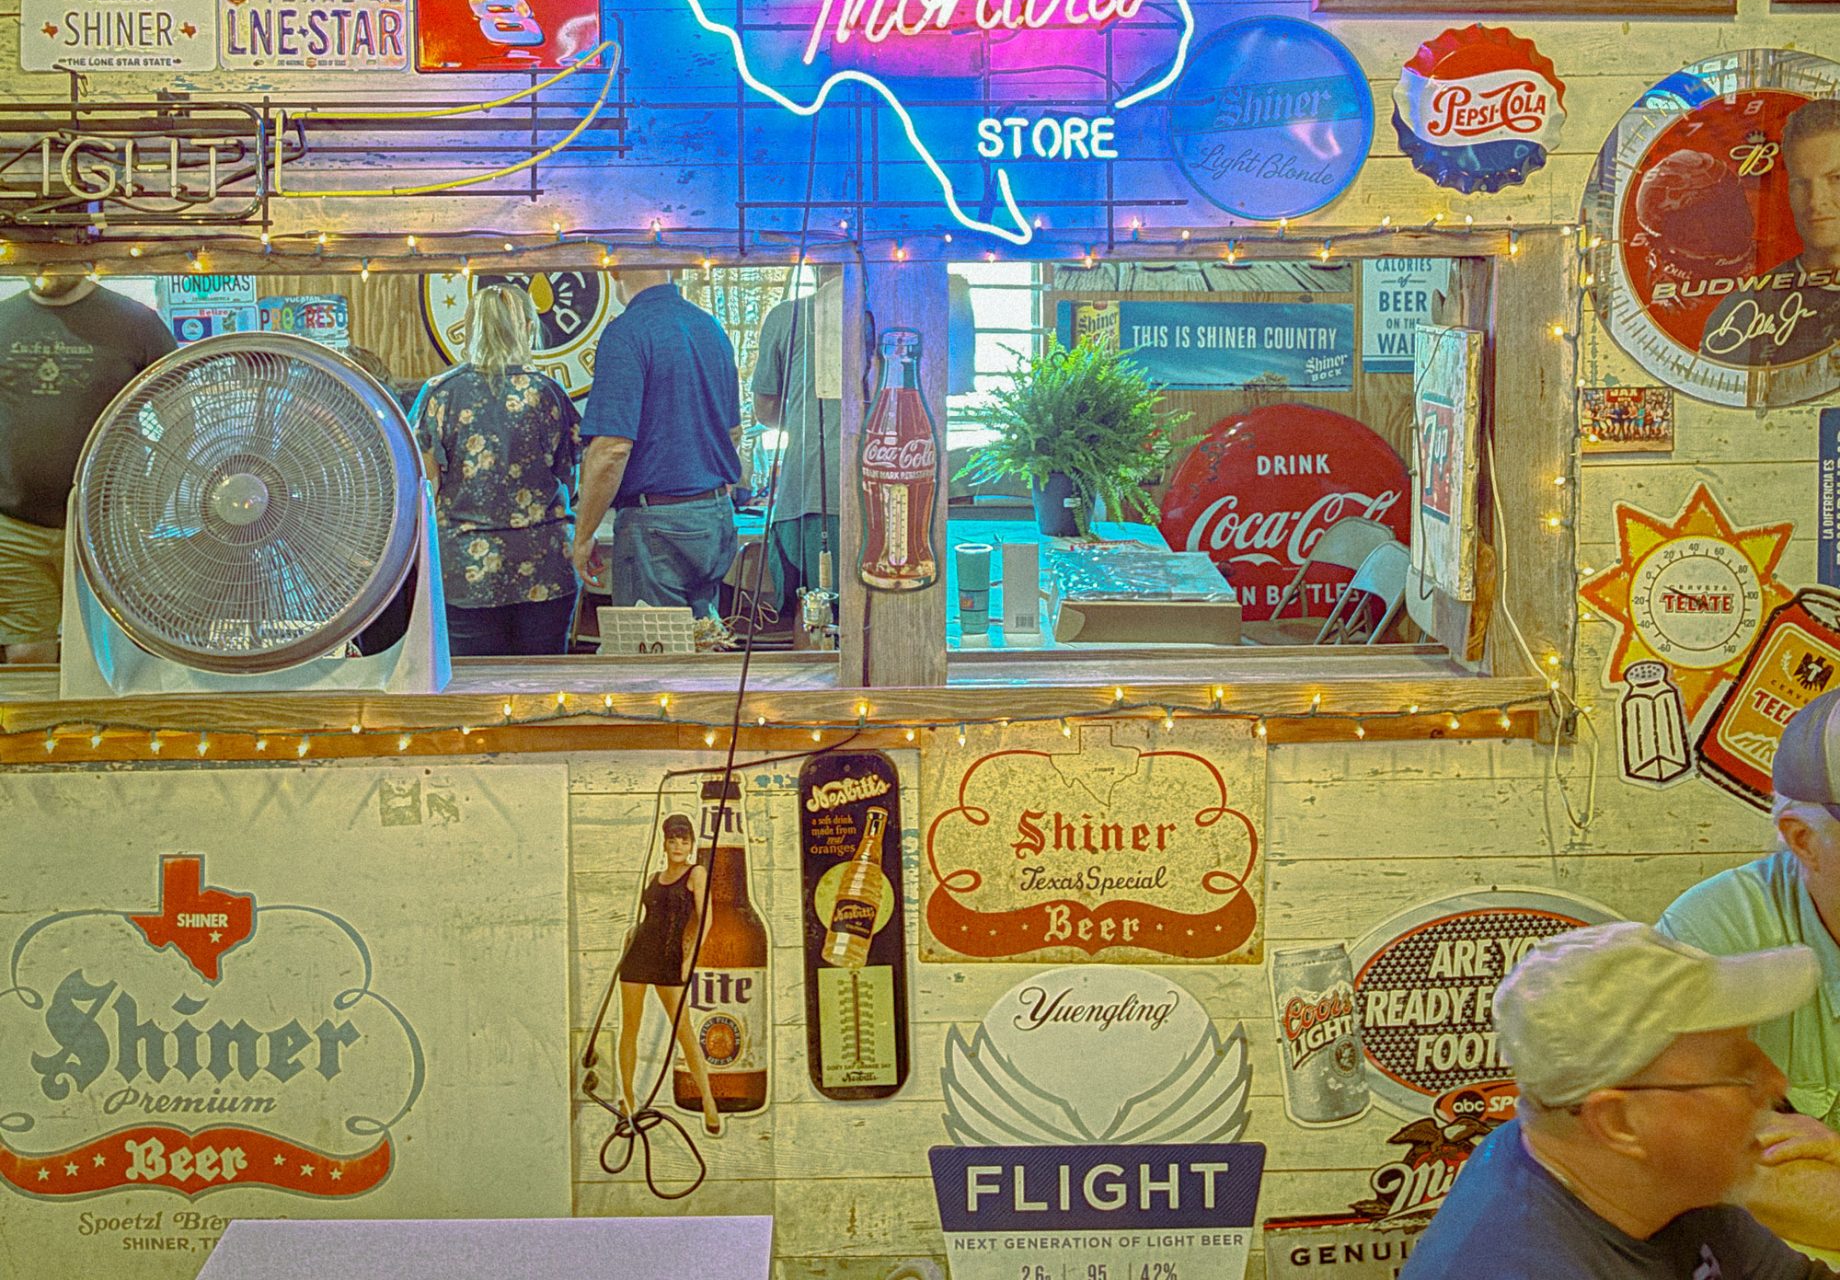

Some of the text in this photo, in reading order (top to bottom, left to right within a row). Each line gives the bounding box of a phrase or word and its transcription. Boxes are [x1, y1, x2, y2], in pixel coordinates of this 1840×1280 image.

[63, 11, 174, 47] SHINER
[307, 9, 403, 56] STAR
[67, 57, 172, 67] THE LONE STAR STATE
[1216, 85, 1333, 127] Shiner
[977, 117, 1119, 160] STORE
[1190, 144, 1335, 187] Light Blonde
[1375, 258, 1432, 272] CALORIES
[171, 275, 250, 294] HONDURAS
[1378, 290, 1428, 313] BEER
[1078, 310, 1119, 335] Shiner
[1132, 325, 1337, 351] THIS IS SHINER COUNTRY
[1386, 317, 1400, 329] ON
[1304, 353, 1348, 374] Shiner
[863, 438, 935, 469] Coca-Cola
[1257, 454, 1331, 477] DRINK
[1823, 459, 1834, 540] LA DIFERENCIA ES
[1661, 594, 1734, 612] TECATE
[806, 774, 891, 813] Nesbitt's
[811, 825, 857, 836] made from
[833, 814, 853, 825] drink
[1010, 808, 1177, 860] Shiner
[810, 842, 856, 857] oranges
[1020, 865, 1169, 896] Texas Special
[176, 912, 229, 929] SHINER
[1043, 903, 1140, 942] Beer
[1428, 939, 1493, 979] ARE
[689, 971, 752, 1011] Lite
[1013, 986, 1180, 1033] Yuengling
[1283, 991, 1353, 1041] Coors
[1364, 987, 1469, 1028] READY
[31, 968, 361, 1101] Shiner
[1288, 1016, 1354, 1070] LIGHT
[103, 1086, 278, 1115] Premium
[1452, 1096, 1485, 1113] abc
[124, 1136, 248, 1182] Beer
[966, 1162, 1229, 1212] FLIGHT
[78, 1211, 163, 1236] Spoetzl
[954, 1233, 1244, 1250] NEXT GENERATION OF LIGHT BEER
